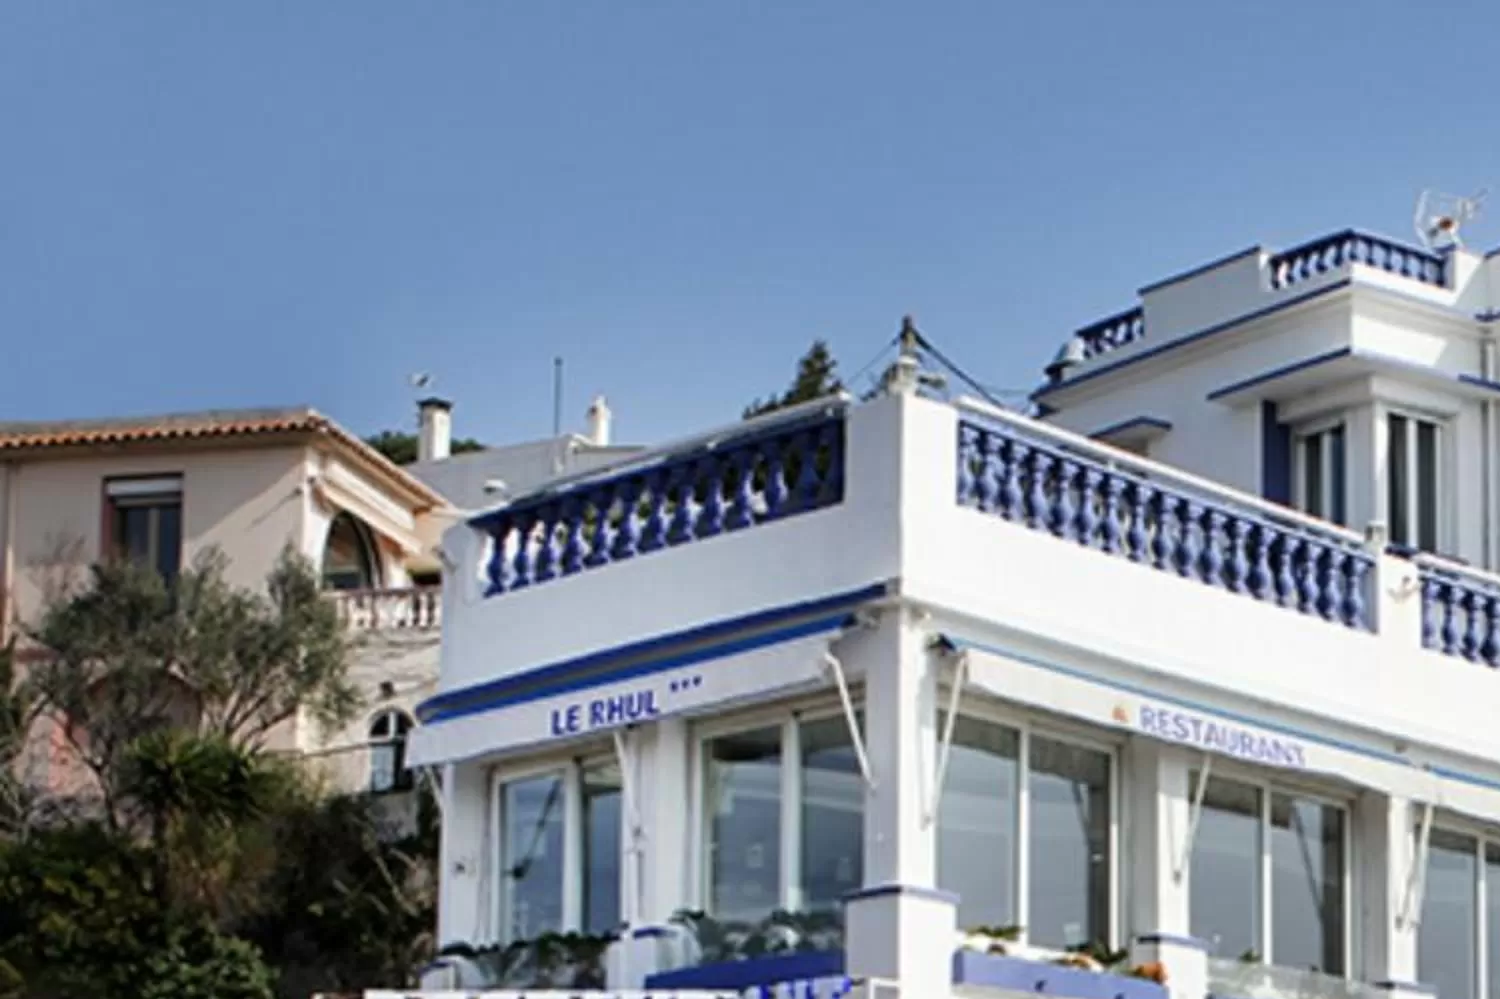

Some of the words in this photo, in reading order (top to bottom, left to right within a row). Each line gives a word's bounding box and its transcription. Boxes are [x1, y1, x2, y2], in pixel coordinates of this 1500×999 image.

[551, 704, 581, 735] LE
[589, 689, 660, 727] RHUL
[1138, 703, 1307, 770] RESTAURANT
